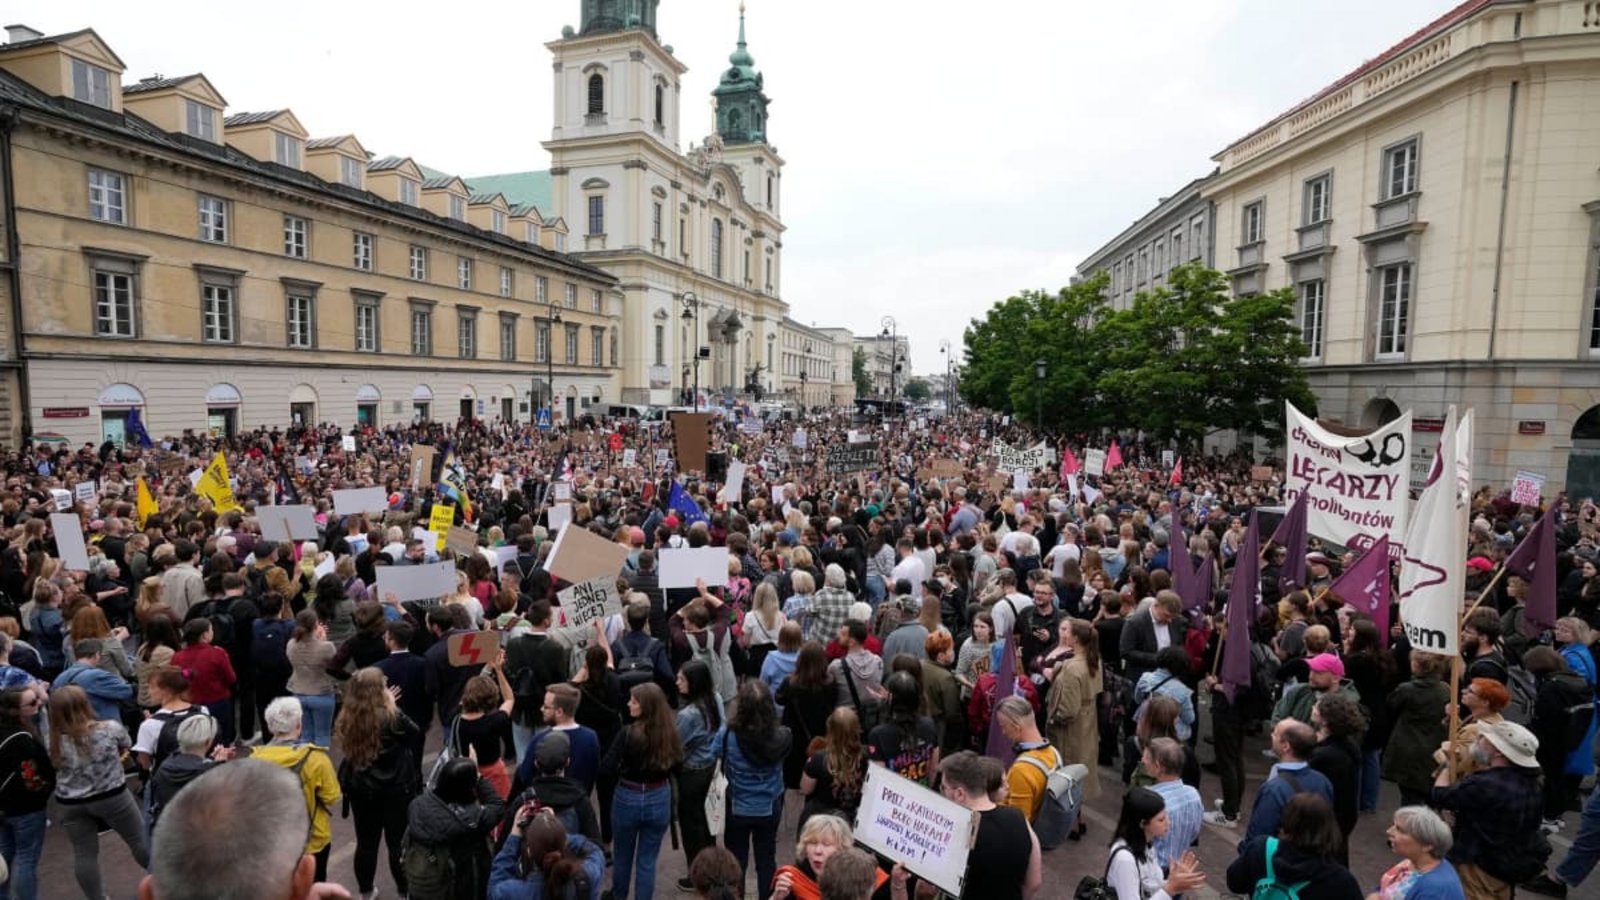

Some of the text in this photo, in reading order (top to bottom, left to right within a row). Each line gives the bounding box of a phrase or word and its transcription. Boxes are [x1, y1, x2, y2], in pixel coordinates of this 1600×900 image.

[1291, 453, 1399, 500] LEKARZY
[573, 582, 593, 599] ANI
[574, 589, 607, 613] JEDNEJ
